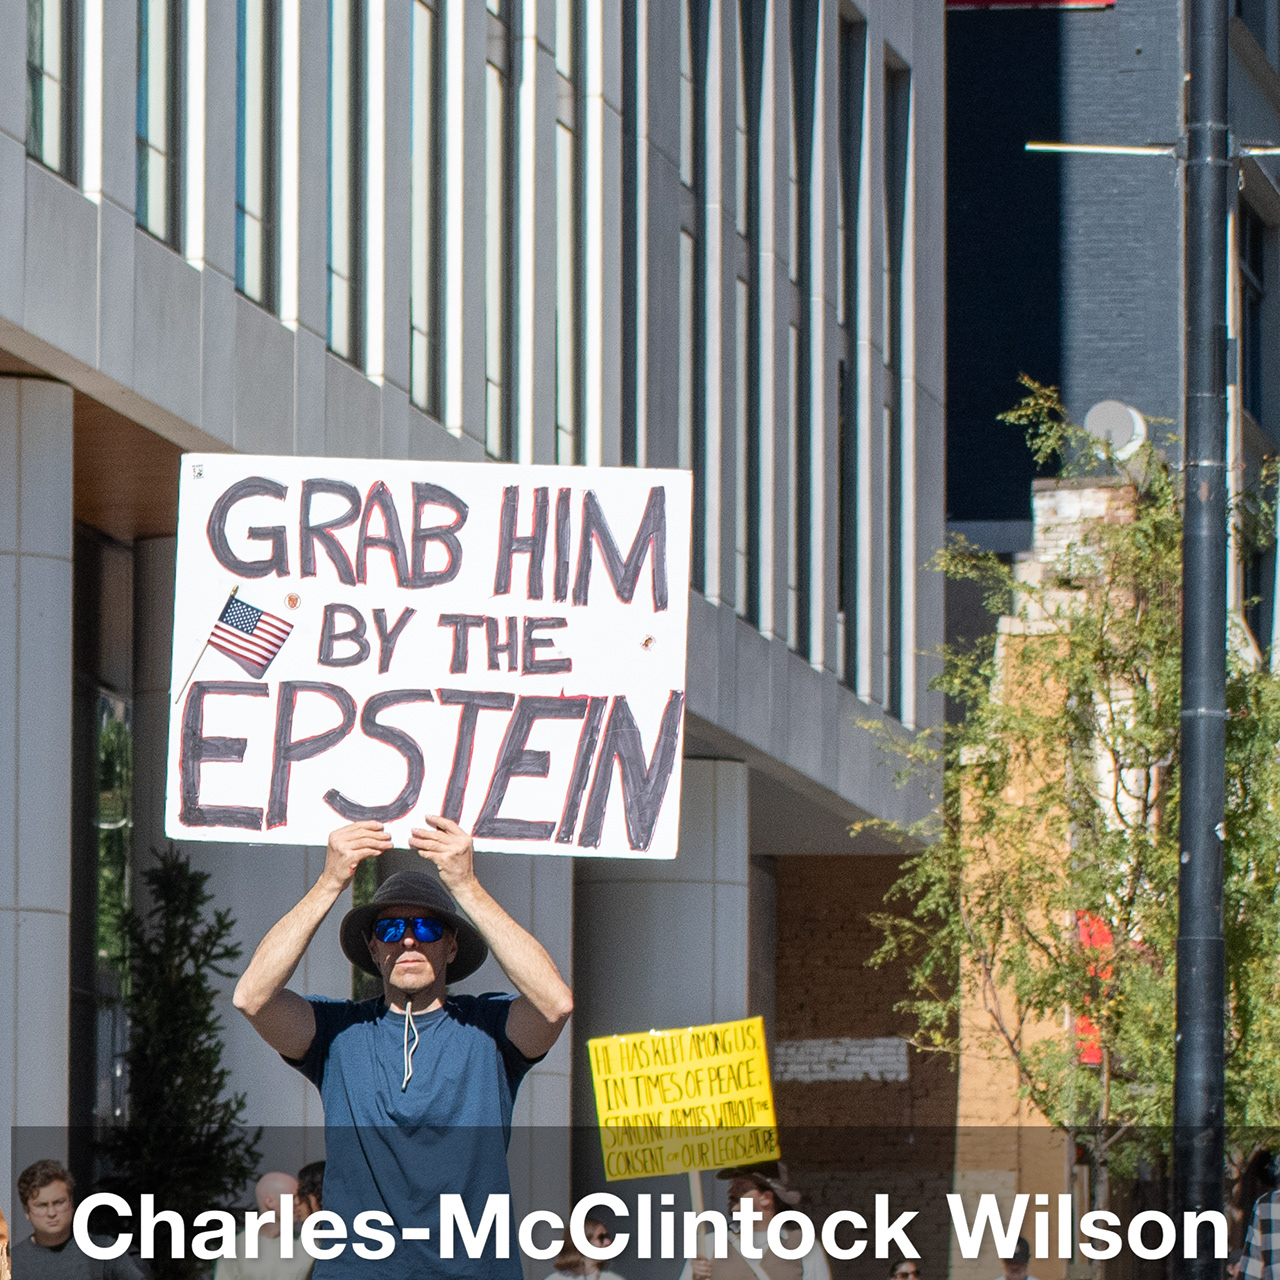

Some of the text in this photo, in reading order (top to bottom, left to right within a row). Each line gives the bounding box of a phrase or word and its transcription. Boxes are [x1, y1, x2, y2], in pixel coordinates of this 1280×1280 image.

[207, 476, 669, 612] GRAB HIM
[317, 603, 572, 676] BY THE
[178, 680, 684, 851] EPSTEIN
[594, 1045, 611, 1076] HE
[620, 1040, 650, 1072] HAS
[652, 1033, 685, 1066] KEPT
[689, 1028, 733, 1061] AMONG
[603, 1076, 628, 1112] IN
[630, 1071, 683, 1108] TIMES
[685, 1068, 706, 1099] OF
[604, 1111, 664, 1150] STANDING
[711, 1096, 756, 1131] WITHOUT
[755, 1100, 770, 1112] THE
[606, 1145, 665, 1178] CONSENT
[681, 1142, 710, 1169] OUR
